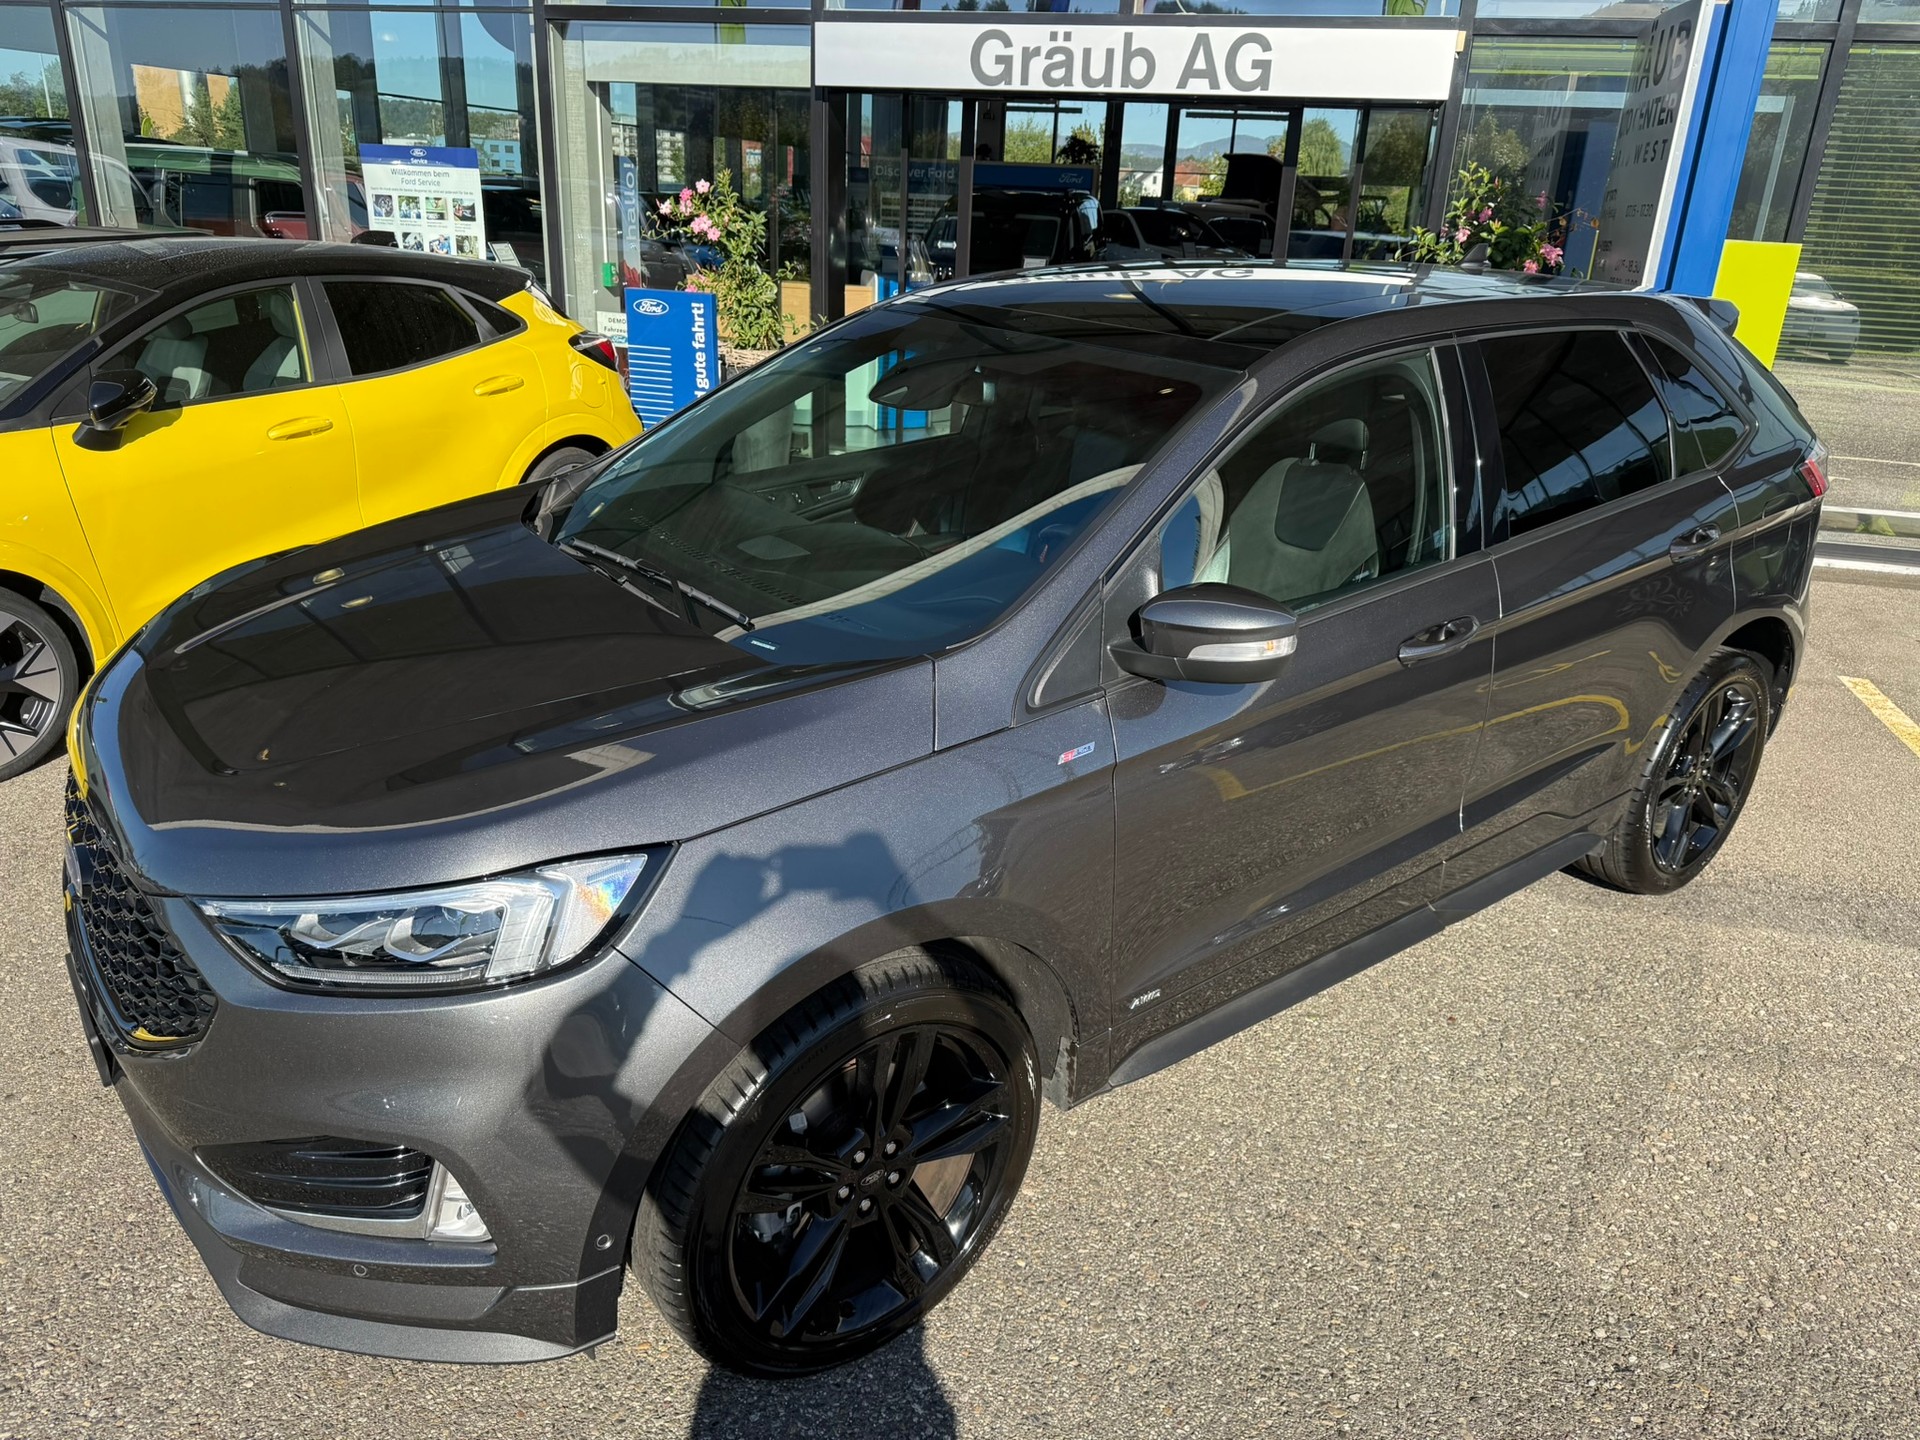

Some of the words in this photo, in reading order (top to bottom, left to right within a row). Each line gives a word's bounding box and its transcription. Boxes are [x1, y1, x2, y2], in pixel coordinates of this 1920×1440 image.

[970, 29, 1156, 89] Gräub
[1176, 32, 1273, 92] AG
[1632, 93, 1678, 131] CENTER
[1633, 139, 1669, 164] WEST
[390, 168, 432, 178] Willkommen
[433, 170, 450, 178] beim
[401, 177, 416, 186] Ford
[418, 179, 441, 187] Service
[876, 165, 927, 178] Discver
[928, 168, 955, 180] Ford
[1058, 173, 1084, 184] Ford
[639, 300, 663, 313] Ford
[691, 302, 706, 350] fahrt!
[694, 351, 710, 390] gute
